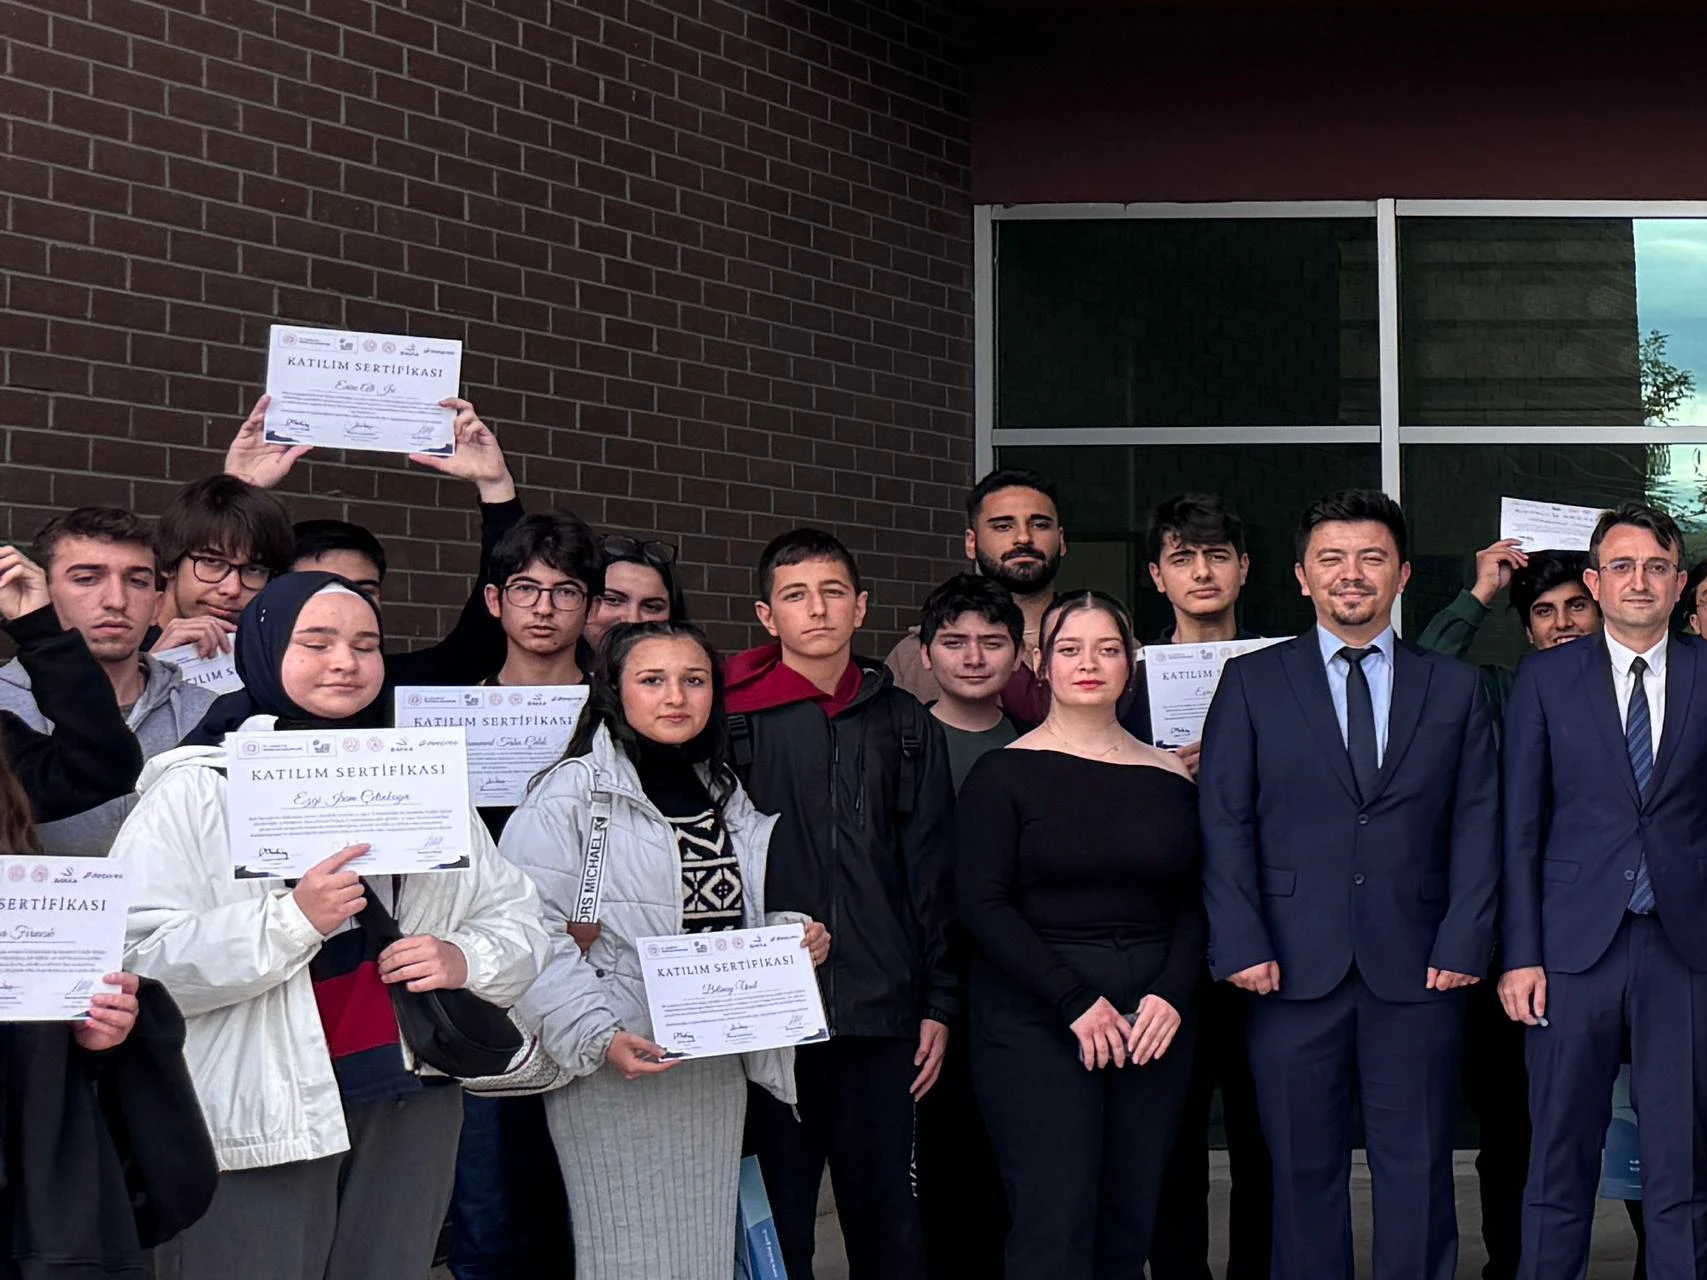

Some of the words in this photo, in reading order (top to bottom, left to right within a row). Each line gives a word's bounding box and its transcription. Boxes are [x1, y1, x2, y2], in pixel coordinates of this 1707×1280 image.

[287, 356, 350, 371] KATILIM
[1162, 670, 1212, 680] KATILIM
[414, 717, 476, 727] KATILIM
[252, 769, 328, 781] KATILIM
[336, 763, 445, 778] SERTİFİKASI
[584, 837, 602, 893] MICHAEL
[580, 897, 594, 923] ORS
[657, 965, 710, 977] KATILIM
